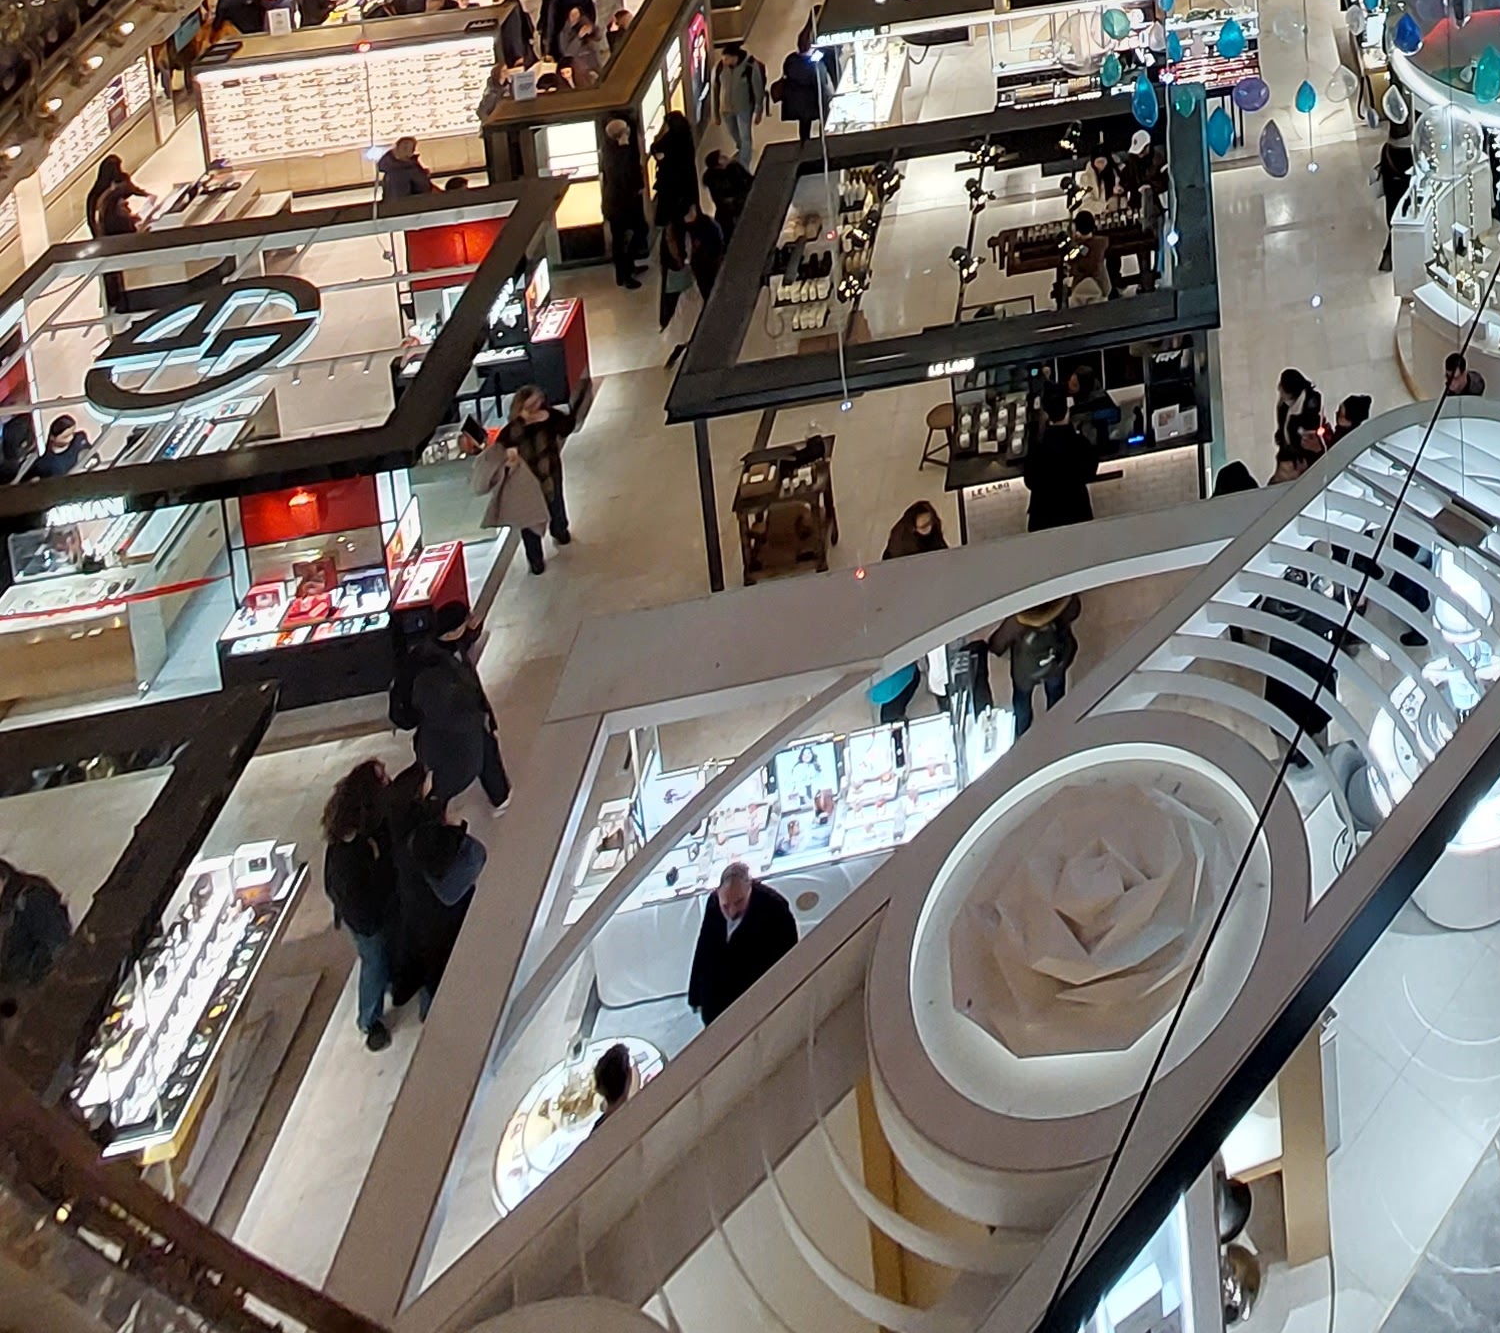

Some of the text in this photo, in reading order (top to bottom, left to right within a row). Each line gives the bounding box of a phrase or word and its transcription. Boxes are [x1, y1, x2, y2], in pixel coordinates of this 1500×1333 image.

[945, 357, 976, 374] LABO
[986, 482, 1011, 493] LABO
[46, 496, 125, 527] ARMANI
